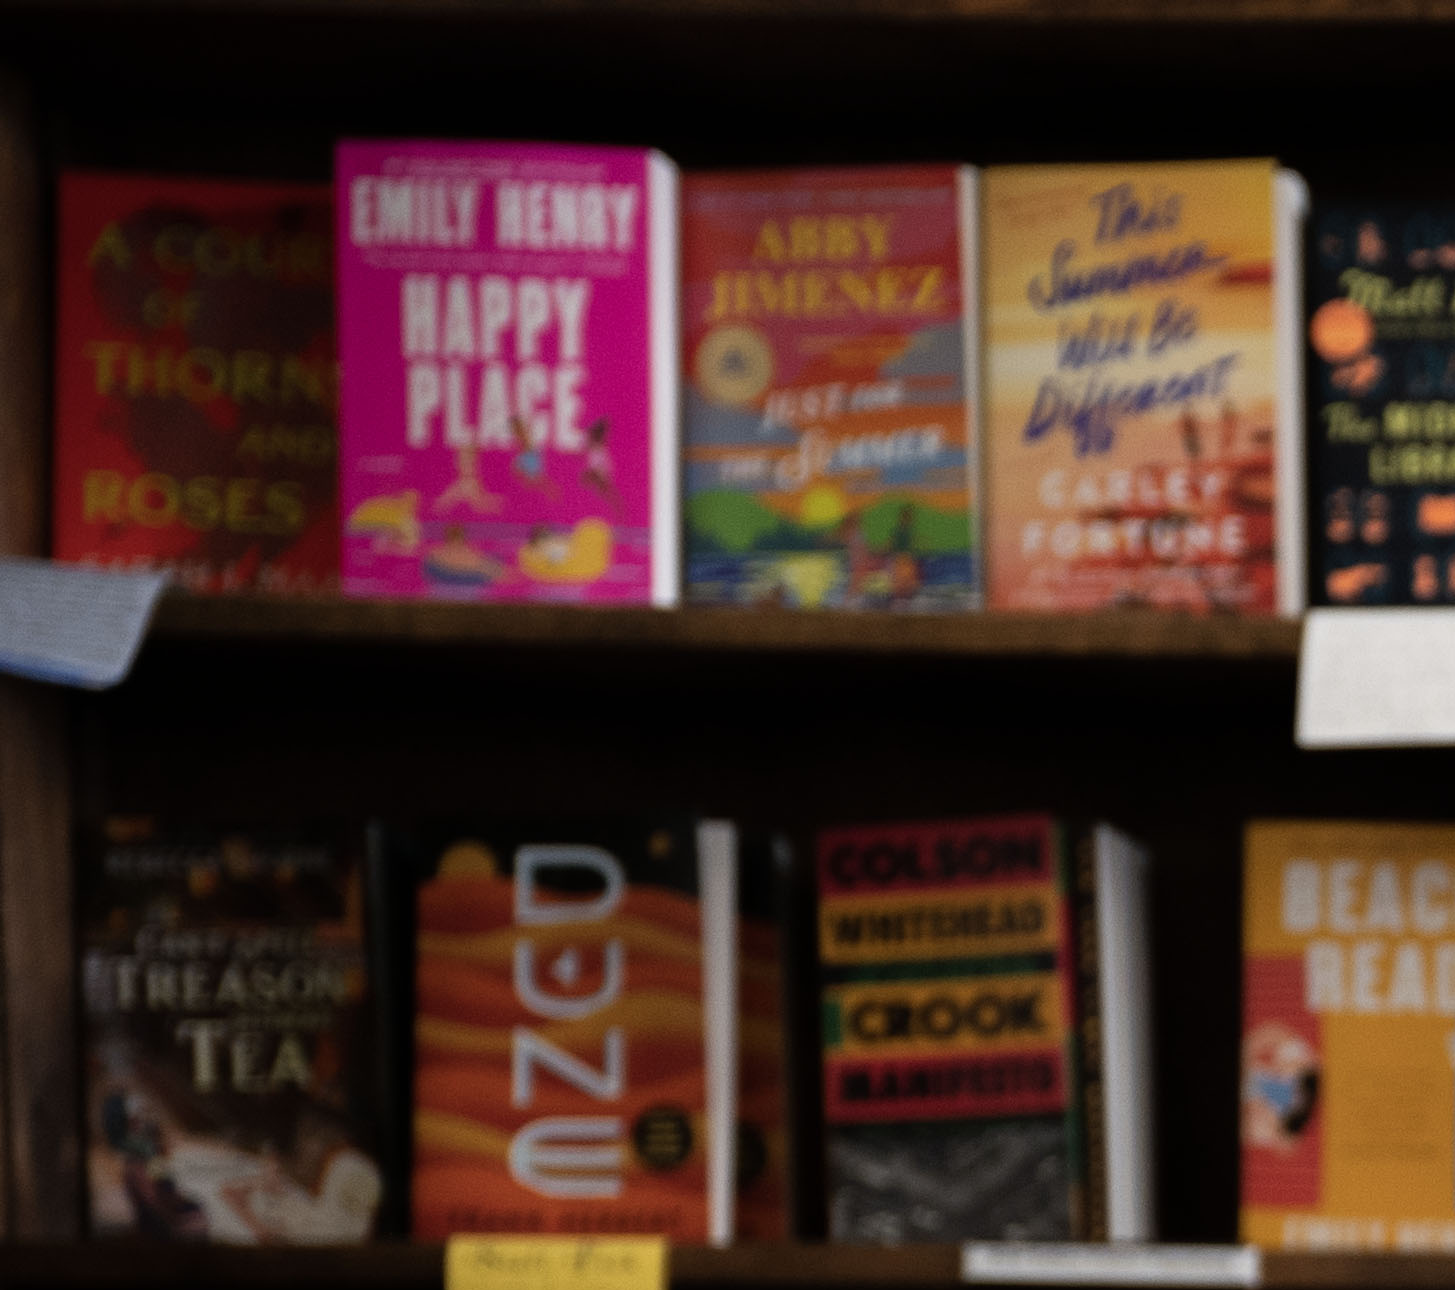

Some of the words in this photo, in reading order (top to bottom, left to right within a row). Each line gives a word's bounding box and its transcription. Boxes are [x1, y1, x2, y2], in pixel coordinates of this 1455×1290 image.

[350, 176, 477, 248] EMILY
[495, 178, 639, 252] HENRY
[750, 217, 891, 262] ABBY
[400, 276, 590, 361] HAPPY
[706, 268, 944, 320] JIMENEZ
[406, 366, 588, 452] PLACE
[83, 470, 303, 534] ROSES
[1038, 469, 1227, 509] CARLEY
[1022, 518, 1247, 559] FORTUNE
[828, 830, 1043, 888] COLSON
[830, 903, 1046, 946] WHITEHEAD
[116, 956, 344, 1010] TREASON
[850, 993, 1046, 1044] CROOK
[176, 1021, 312, 1092] TEA
